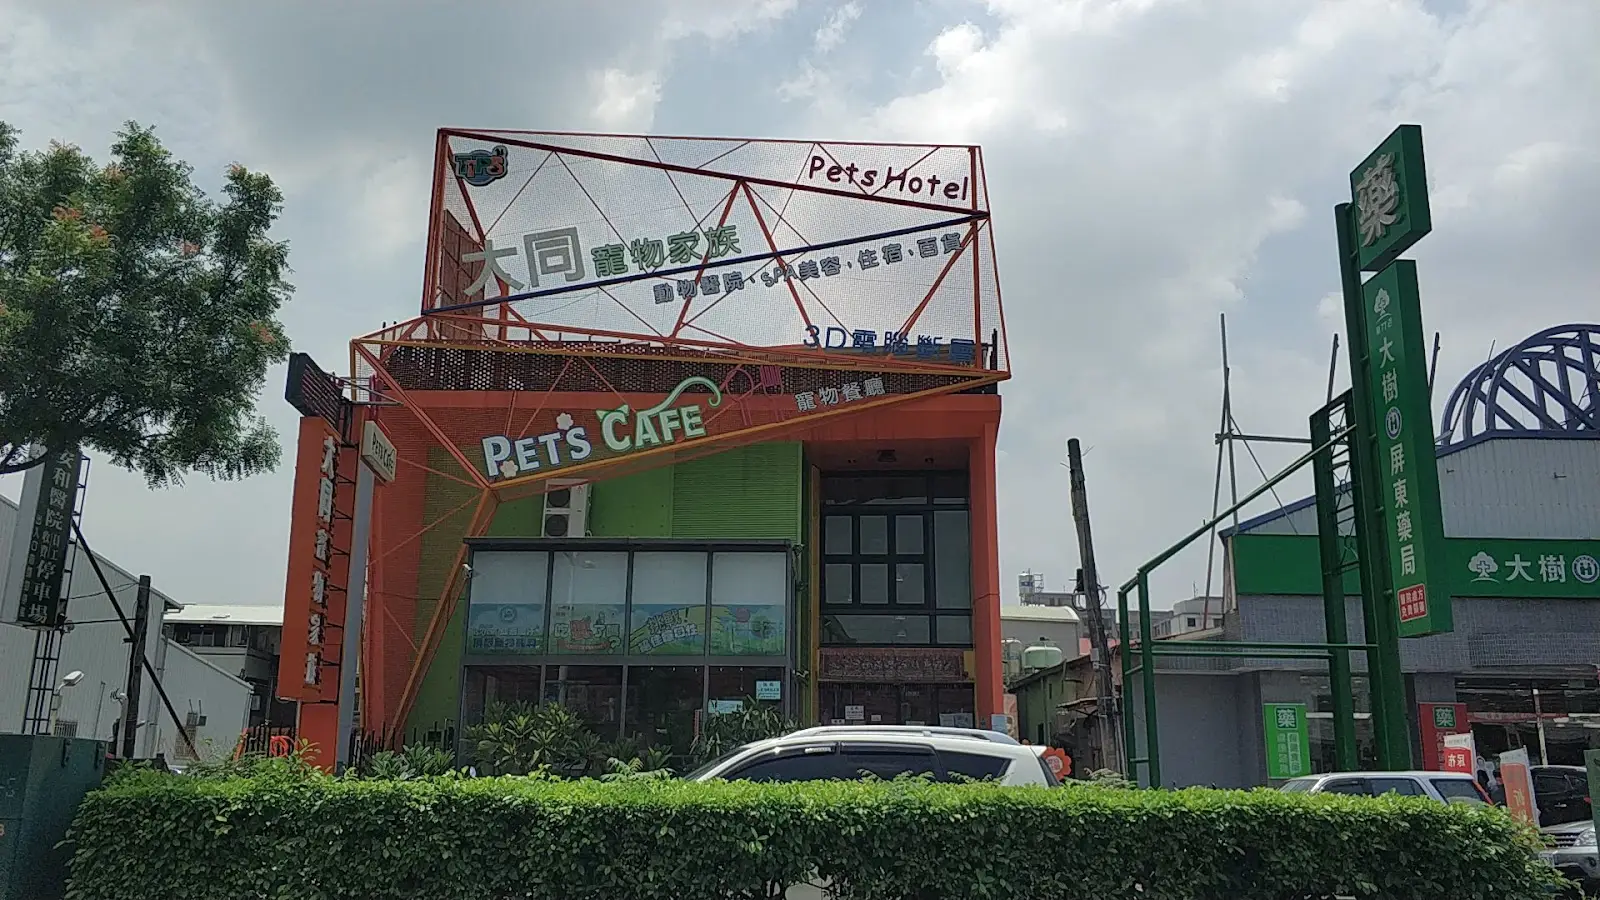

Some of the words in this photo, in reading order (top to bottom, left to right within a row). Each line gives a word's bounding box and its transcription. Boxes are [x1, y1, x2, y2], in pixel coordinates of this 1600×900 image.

[809, 155, 877, 187] Pets
[884, 166, 968, 201] Hotel
[1356, 151, 1399, 247] 藥
[462, 227, 586, 297] 大同
[591, 225, 742, 278] 寵物家族
[795, 377, 885, 412] 寵物餐廳
[597, 404, 706, 451] CAFE
[1379, 336, 1398, 405] 大樹
[1390, 443, 1417, 577] 屏東藥局
[1504, 553, 1566, 583] 大樹
[1278, 709, 1296, 727] 藥
[1436, 708, 1454, 727] 藥
